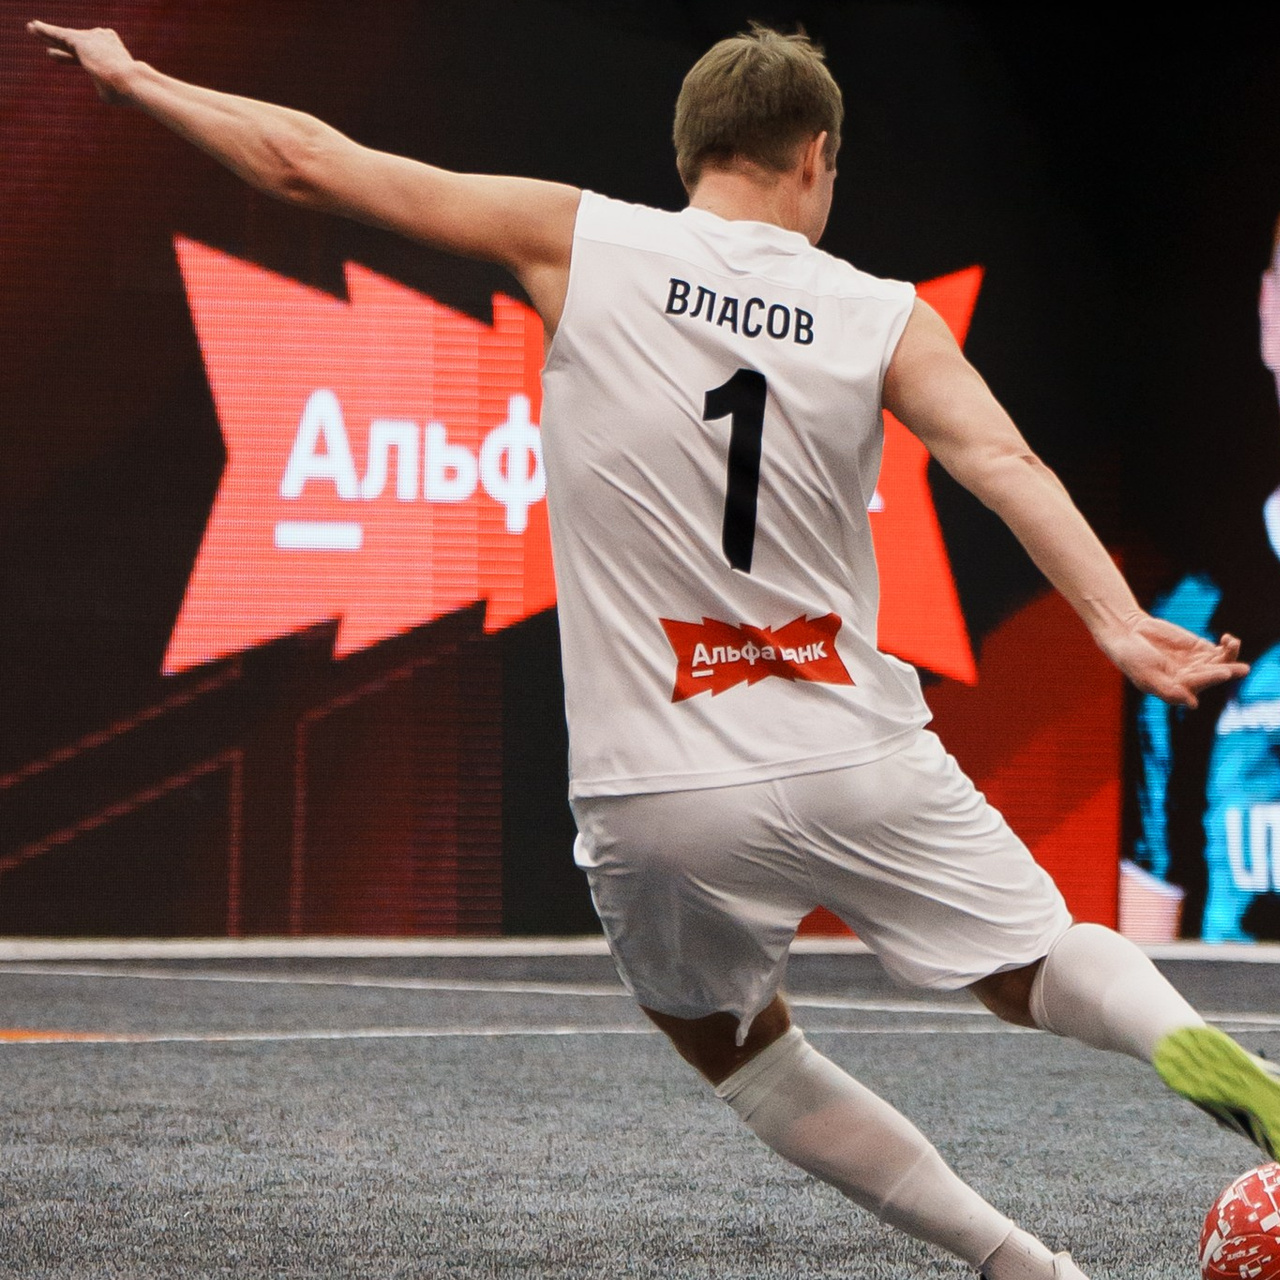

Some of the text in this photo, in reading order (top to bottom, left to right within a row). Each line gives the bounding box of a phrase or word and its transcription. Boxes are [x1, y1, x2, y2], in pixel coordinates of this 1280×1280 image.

[665, 278, 814, 345] ВЛАСОВ
[279, 387, 547, 536] Альф
[703, 368, 767, 574] 1
[692, 641, 776, 670] Альфа
